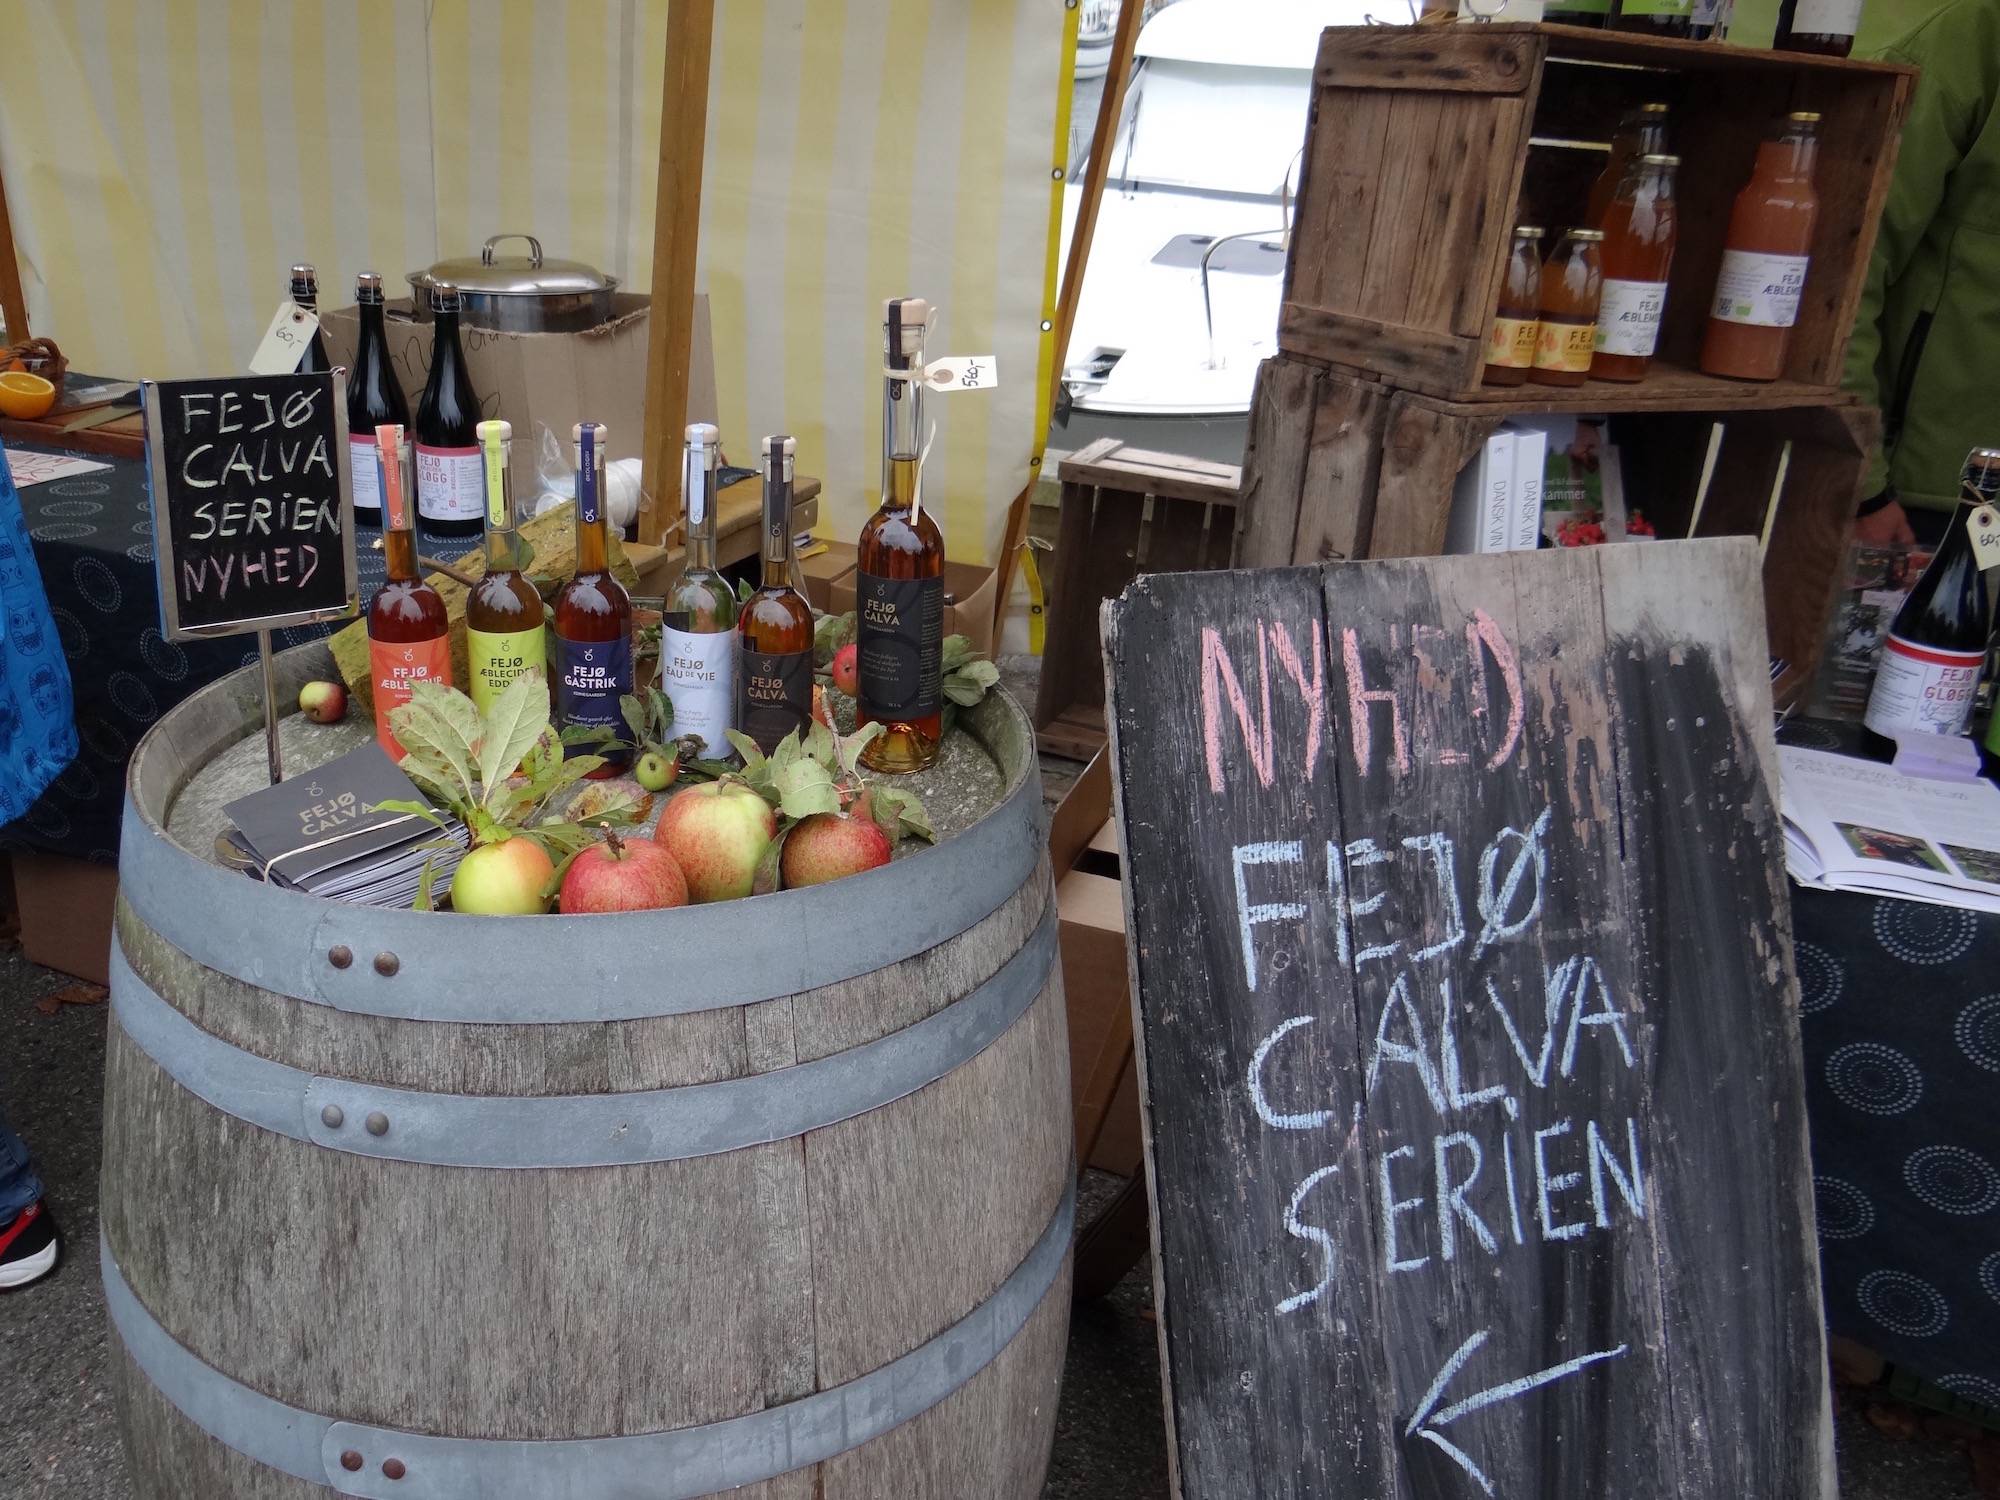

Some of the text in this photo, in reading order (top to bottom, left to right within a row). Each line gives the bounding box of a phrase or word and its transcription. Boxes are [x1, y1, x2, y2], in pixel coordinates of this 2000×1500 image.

[180, 387, 322, 435] FEJØ
[182, 434, 334, 489] CALVA
[1489, 480, 1507, 547] DANSK VIN
[1519, 480, 1538, 547] DANSK VIN
[183, 544, 319, 602] NYHED
[867, 598, 896, 614] FEJØ
[864, 609, 901, 626] CALVA
[490, 656, 523, 668] FEJØ
[674, 657, 704, 670] FEJØ
[393, 665, 428, 678] FEJØ
[573, 665, 606, 678] FEJØ
[666, 665, 683, 679] EAU
[697, 671, 716, 681] VIE
[488, 679, 513, 688] EDD
[564, 674, 617, 689] GASTRIK
[751, 675, 783, 689] FEJØ
[747, 686, 788, 700] CALVA
[299, 791, 356, 823] FEJØ
[301, 801, 376, 836] CALVA
[1231, 805, 1552, 994] FEJØ
[1247, 954, 1637, 1131] CALVA
[1274, 1117, 1645, 1316] SERIEN
